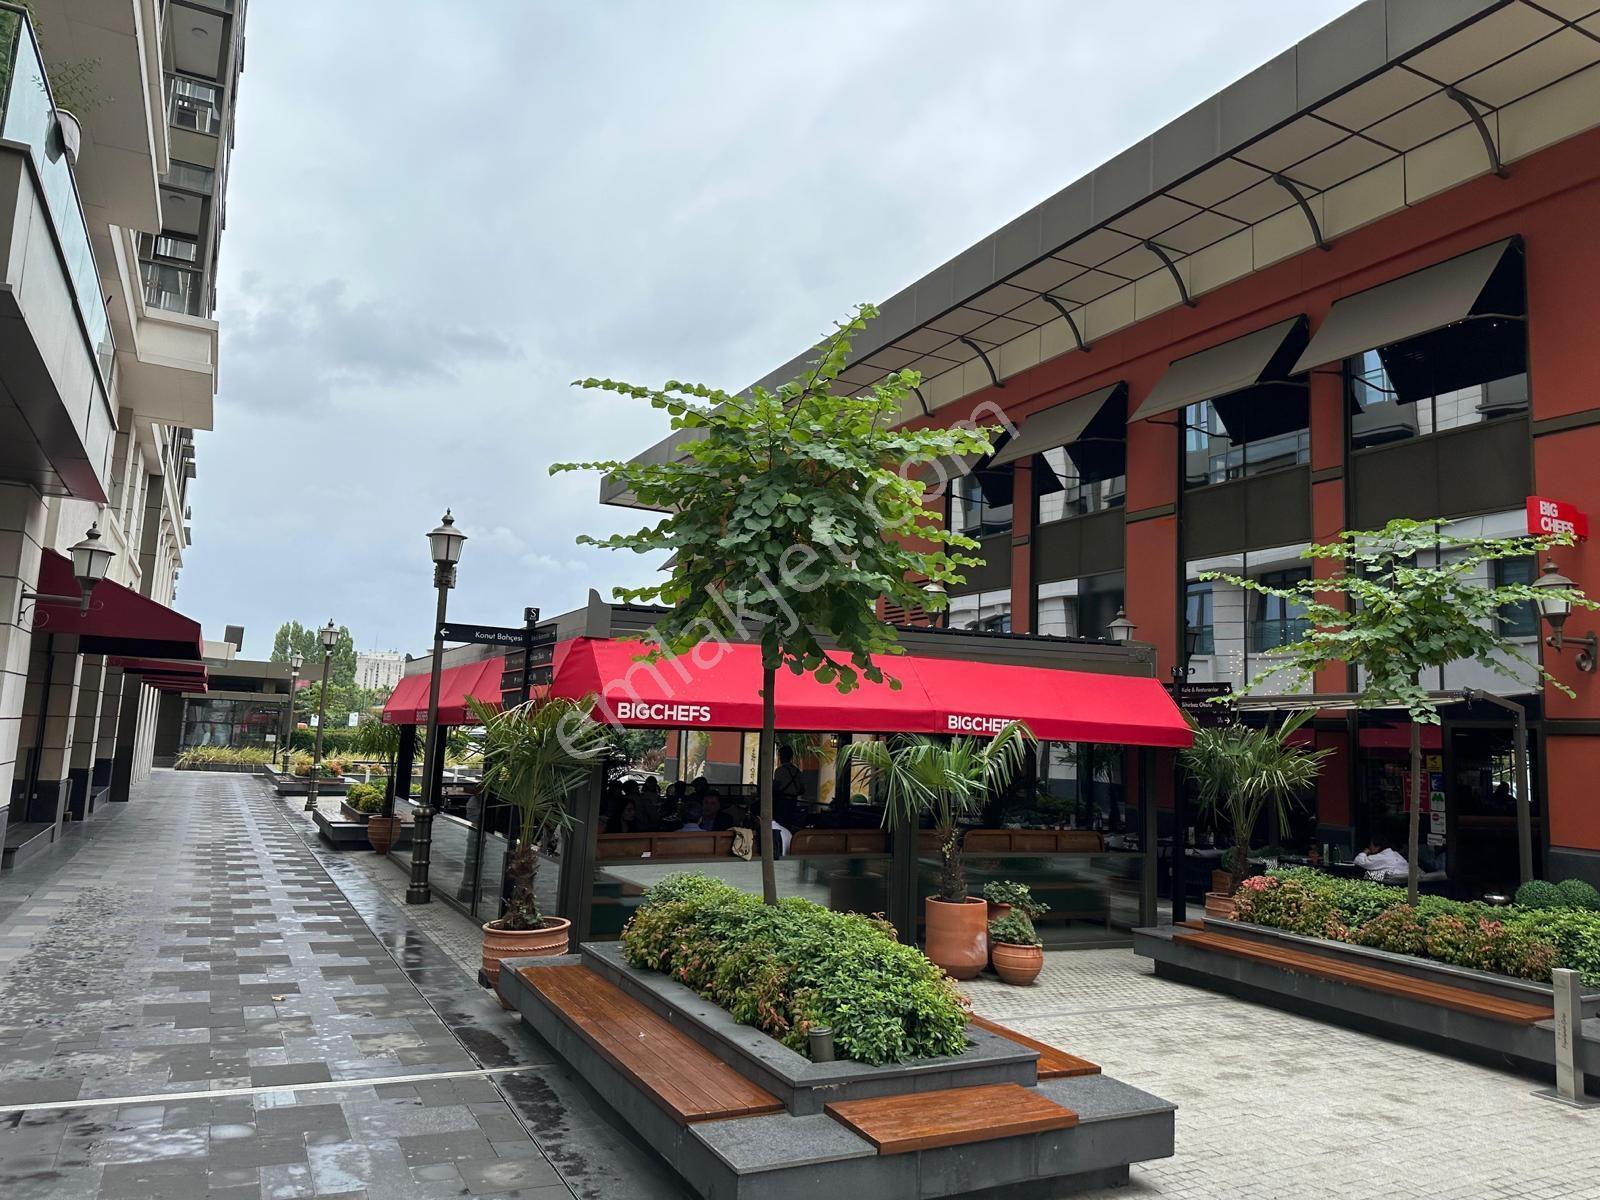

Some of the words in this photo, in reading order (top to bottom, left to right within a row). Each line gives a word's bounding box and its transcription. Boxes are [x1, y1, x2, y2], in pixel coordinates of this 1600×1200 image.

[1540, 500, 1558, 517] BIG
[475, 631, 496, 640] Konut
[497, 632, 523, 643] Bahçesi
[617, 702, 711, 722] BIGCHEFS
[947, 714, 1017, 733] BIGCHEF
